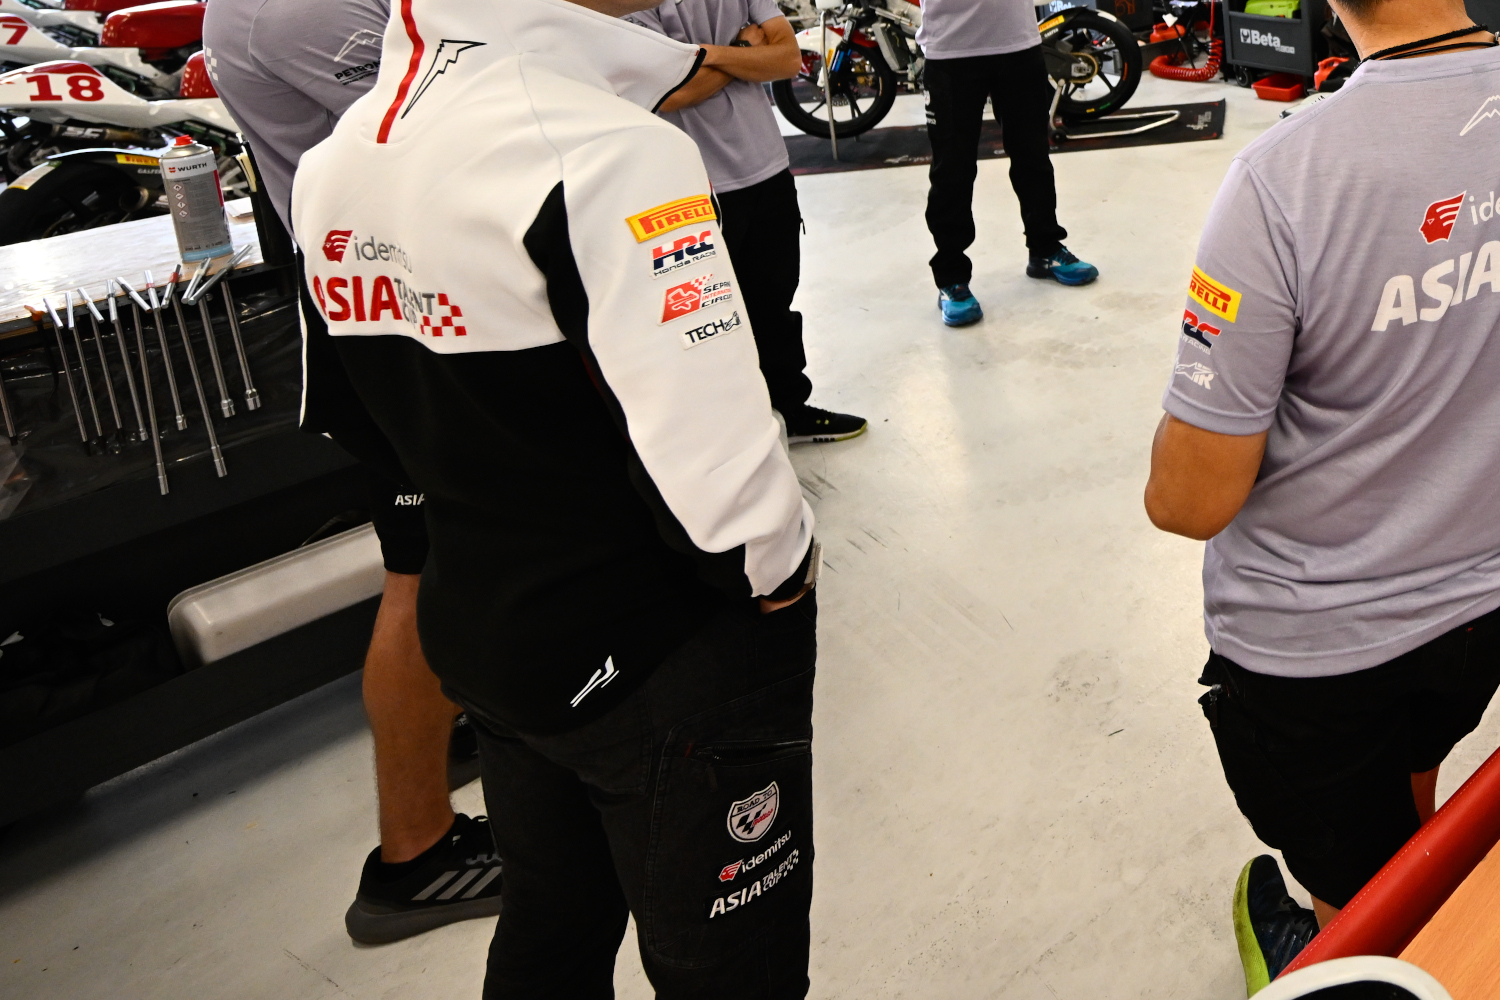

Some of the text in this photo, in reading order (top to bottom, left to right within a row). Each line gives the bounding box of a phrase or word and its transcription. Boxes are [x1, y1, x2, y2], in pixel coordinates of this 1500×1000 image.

[1251, 30, 1281, 47] Beta
[334, 61, 381, 80] PETRON
[27, 75, 105, 101] 18
[638, 198, 713, 235] PIRELLI
[652, 230, 714, 270] HRC
[654, 260, 691, 277] Honda
[313, 275, 403, 322] ASIA
[1189, 271, 1231, 313] RELLI
[685, 319, 725, 343] TECH
[1183, 309, 1221, 349] RC
[395, 494, 425, 507] ASIA
[736, 789, 773, 813] ROAD TO
[742, 830, 791, 873] idemitsu
[763, 852, 793, 884] TALENT
[763, 872, 782, 891] CUP
[709, 880, 761, 919] ASIA
